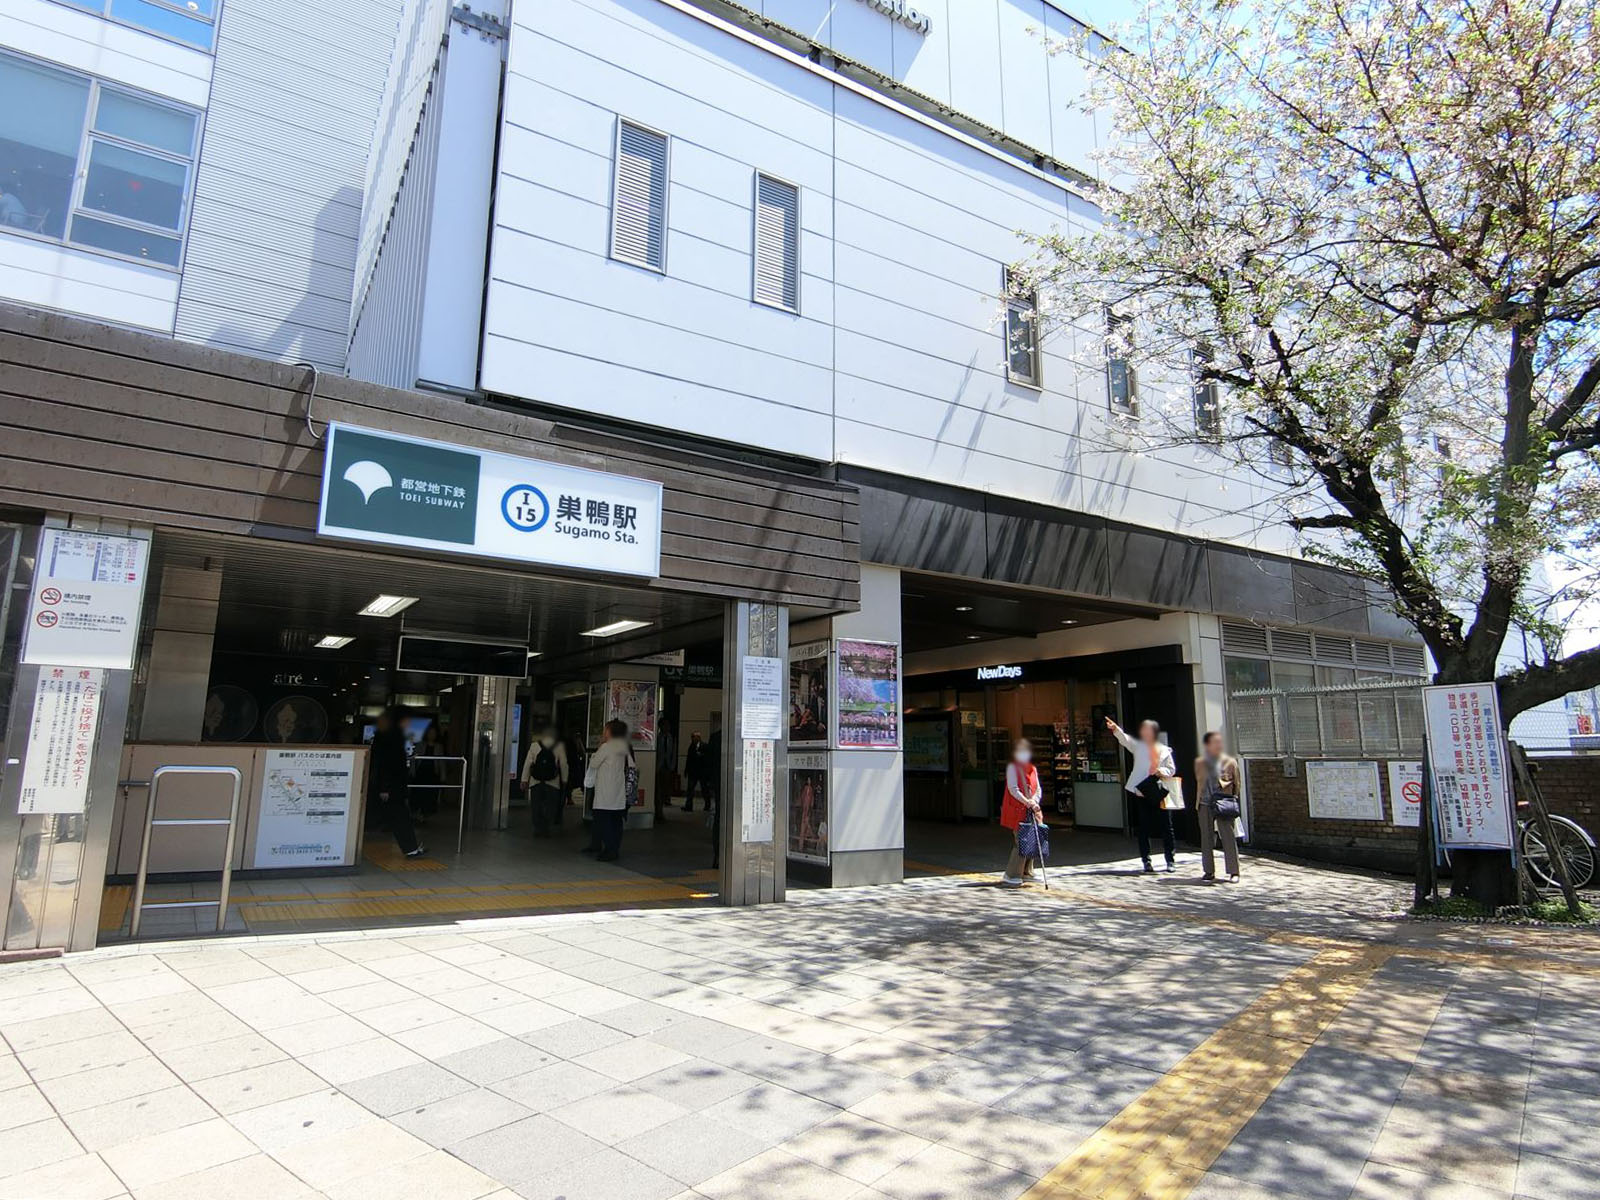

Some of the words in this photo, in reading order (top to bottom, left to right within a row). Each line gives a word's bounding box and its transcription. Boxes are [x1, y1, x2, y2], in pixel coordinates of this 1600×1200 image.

[863, 0, 933, 37] ation
[400, 477, 466, 499] 都営地下鉄
[399, 491, 422, 504] TOEI
[425, 496, 465, 510] SUBWAY
[555, 493, 637, 530] 巣鴨駅
[516, 506, 537, 523] 15
[554, 521, 610, 541] Sugamo
[614, 530, 639, 545] Sta.
[977, 665, 1022, 680] NewDays
[1470, 692, 1492, 808] 歩行者が迷惑しておりますので
